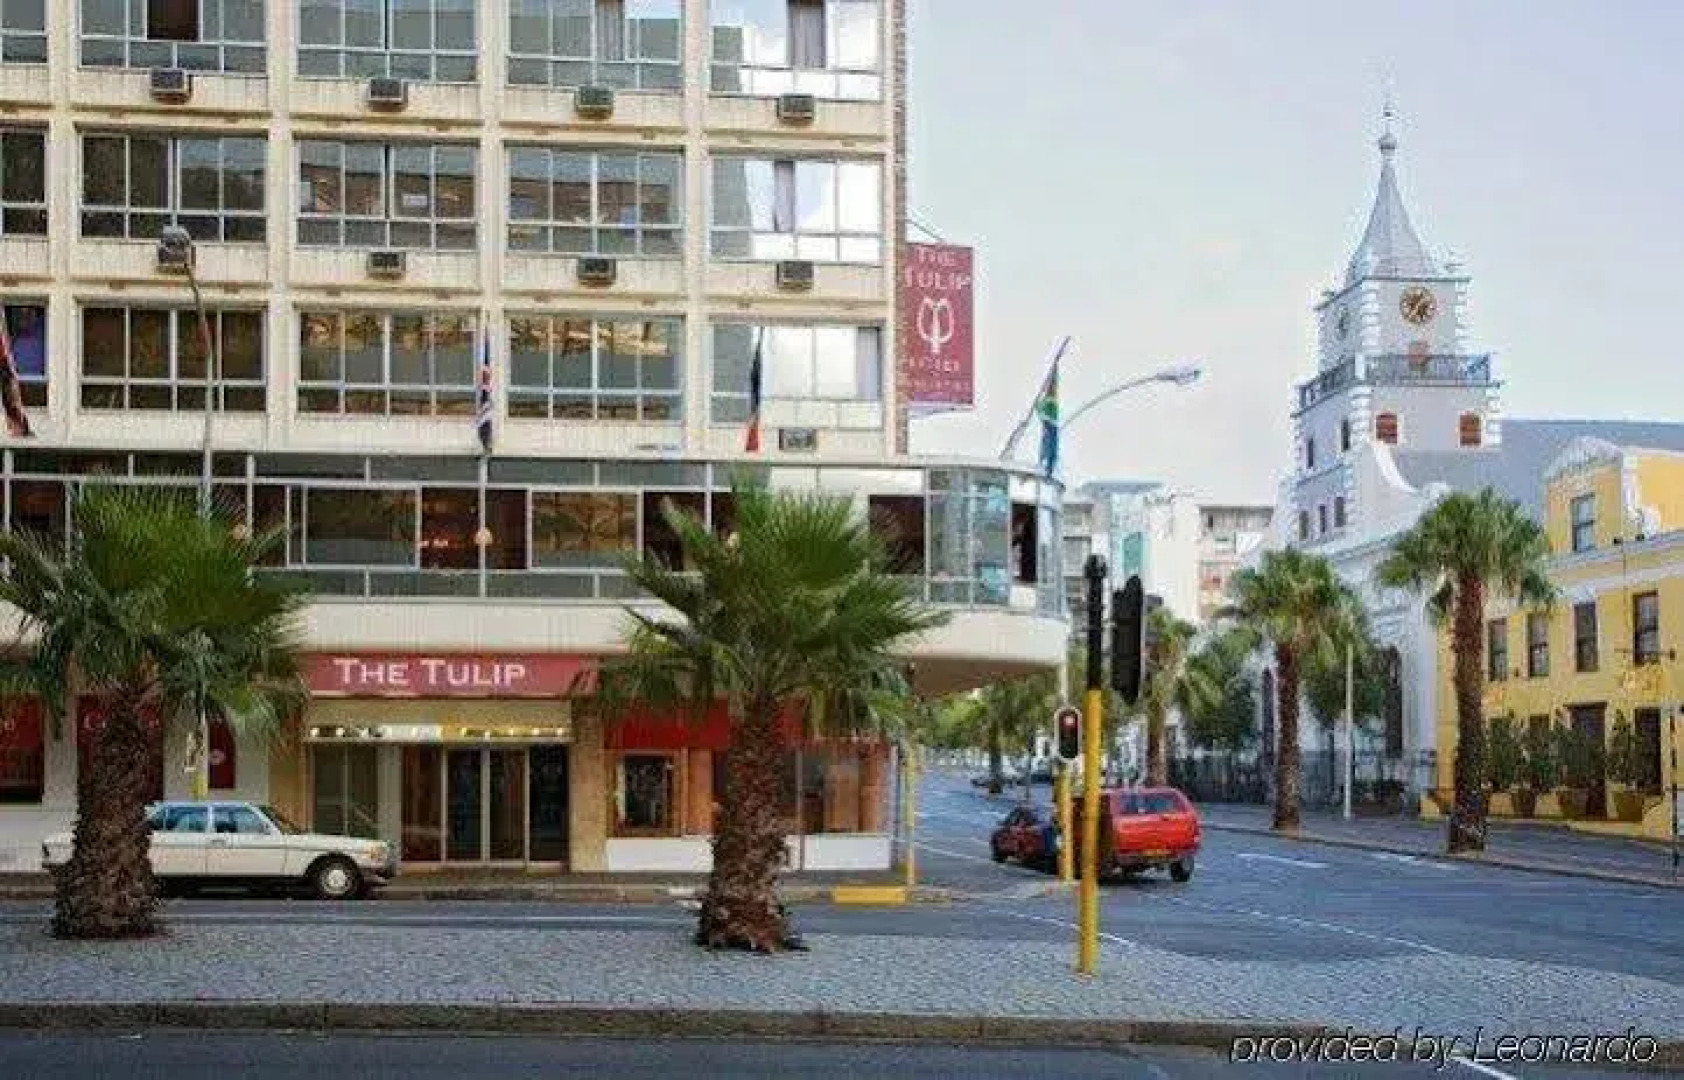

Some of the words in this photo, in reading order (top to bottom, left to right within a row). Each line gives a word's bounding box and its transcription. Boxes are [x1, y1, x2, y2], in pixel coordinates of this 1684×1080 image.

[904, 267, 971, 290] TULIP
[334, 657, 410, 685] THE
[420, 657, 526, 687] TULIP
